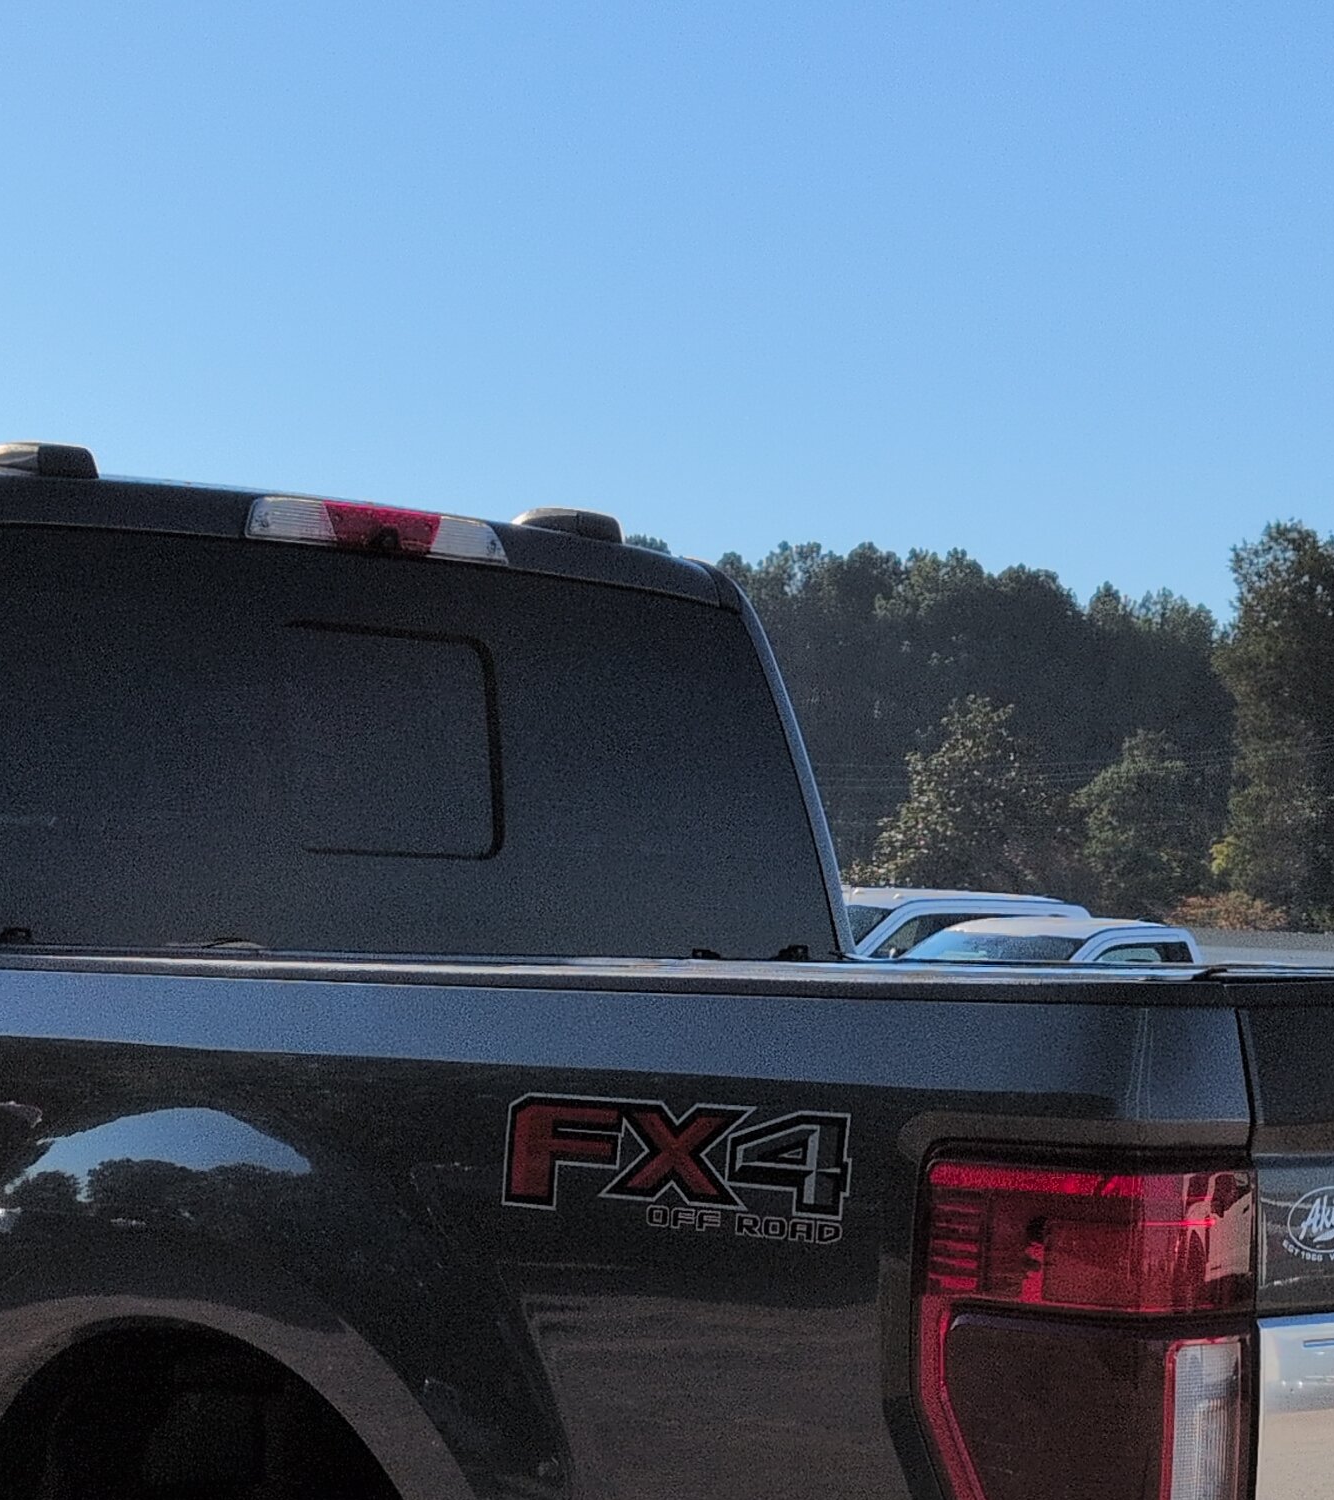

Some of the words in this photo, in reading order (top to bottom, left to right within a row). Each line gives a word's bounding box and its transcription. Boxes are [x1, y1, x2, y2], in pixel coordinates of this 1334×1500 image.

[502, 1091, 853, 1221] FX4
[646, 1204, 721, 1232] OFF
[734, 1215, 843, 1245] ROAD
